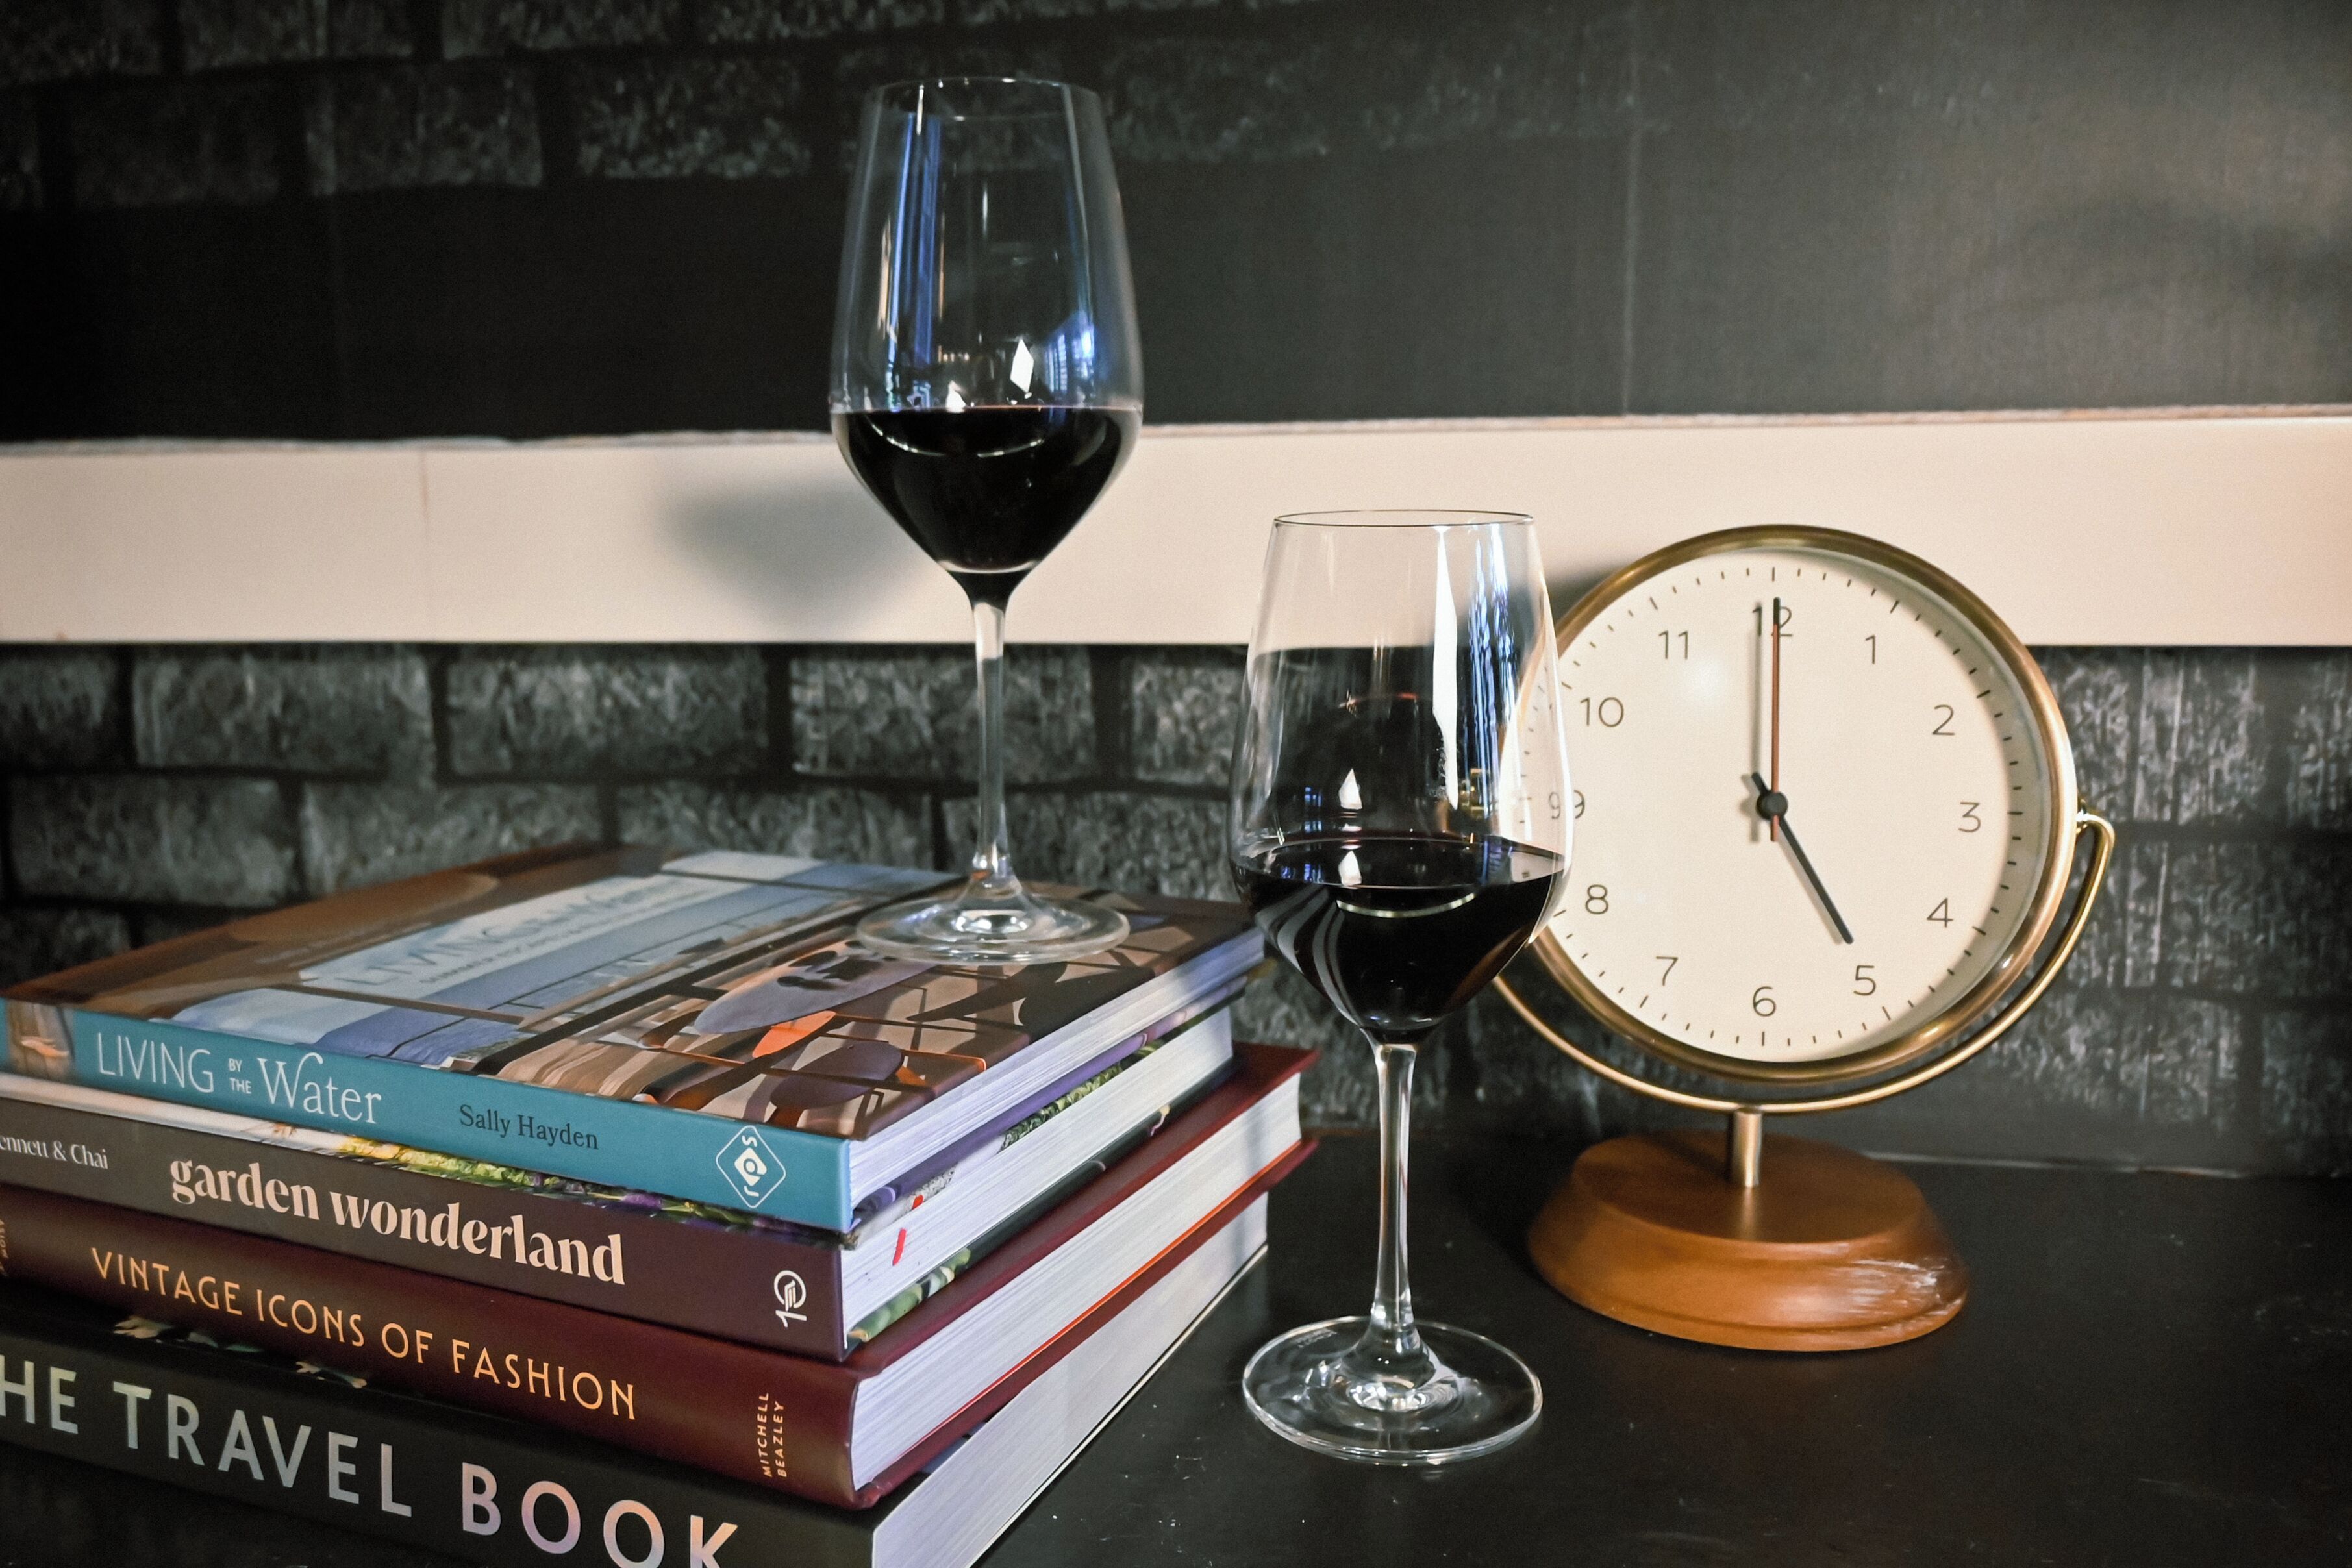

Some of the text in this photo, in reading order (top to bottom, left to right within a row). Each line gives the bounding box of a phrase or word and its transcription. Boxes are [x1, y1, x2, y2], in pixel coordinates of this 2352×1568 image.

[1752, 605, 1793, 637] 12
[1658, 630, 1689, 660] 11
[1865, 634, 1876, 665] 1
[1580, 697, 1625, 728] 10
[1932, 704, 1955, 736] 2
[1958, 801, 1981, 833] 3
[1584, 884, 1609, 915] 8
[1926, 897, 1954, 928] 4
[1655, 956, 1679, 986] 7
[1853, 964, 1877, 997] 5
[1752, 986, 1777, 1017] 6
[97, 1032, 382, 1125] LIVING BY THE Water
[459, 1104, 599, 1151] Sally Hayden
[53, 1139, 68, 1162] &
[69, 1143, 108, 1169] Chai
[169, 1159, 626, 1285] garden wonderland
[91, 1247, 636, 1421] VINTAGE ICONS OF FASHION
[757, 1392, 773, 1478] MITCHELL
[773, 1400, 788, 1478] BEAZLEY
[112, 1380, 412, 1517] TRAVEL
[462, 1462, 738, 1568] BOOK
